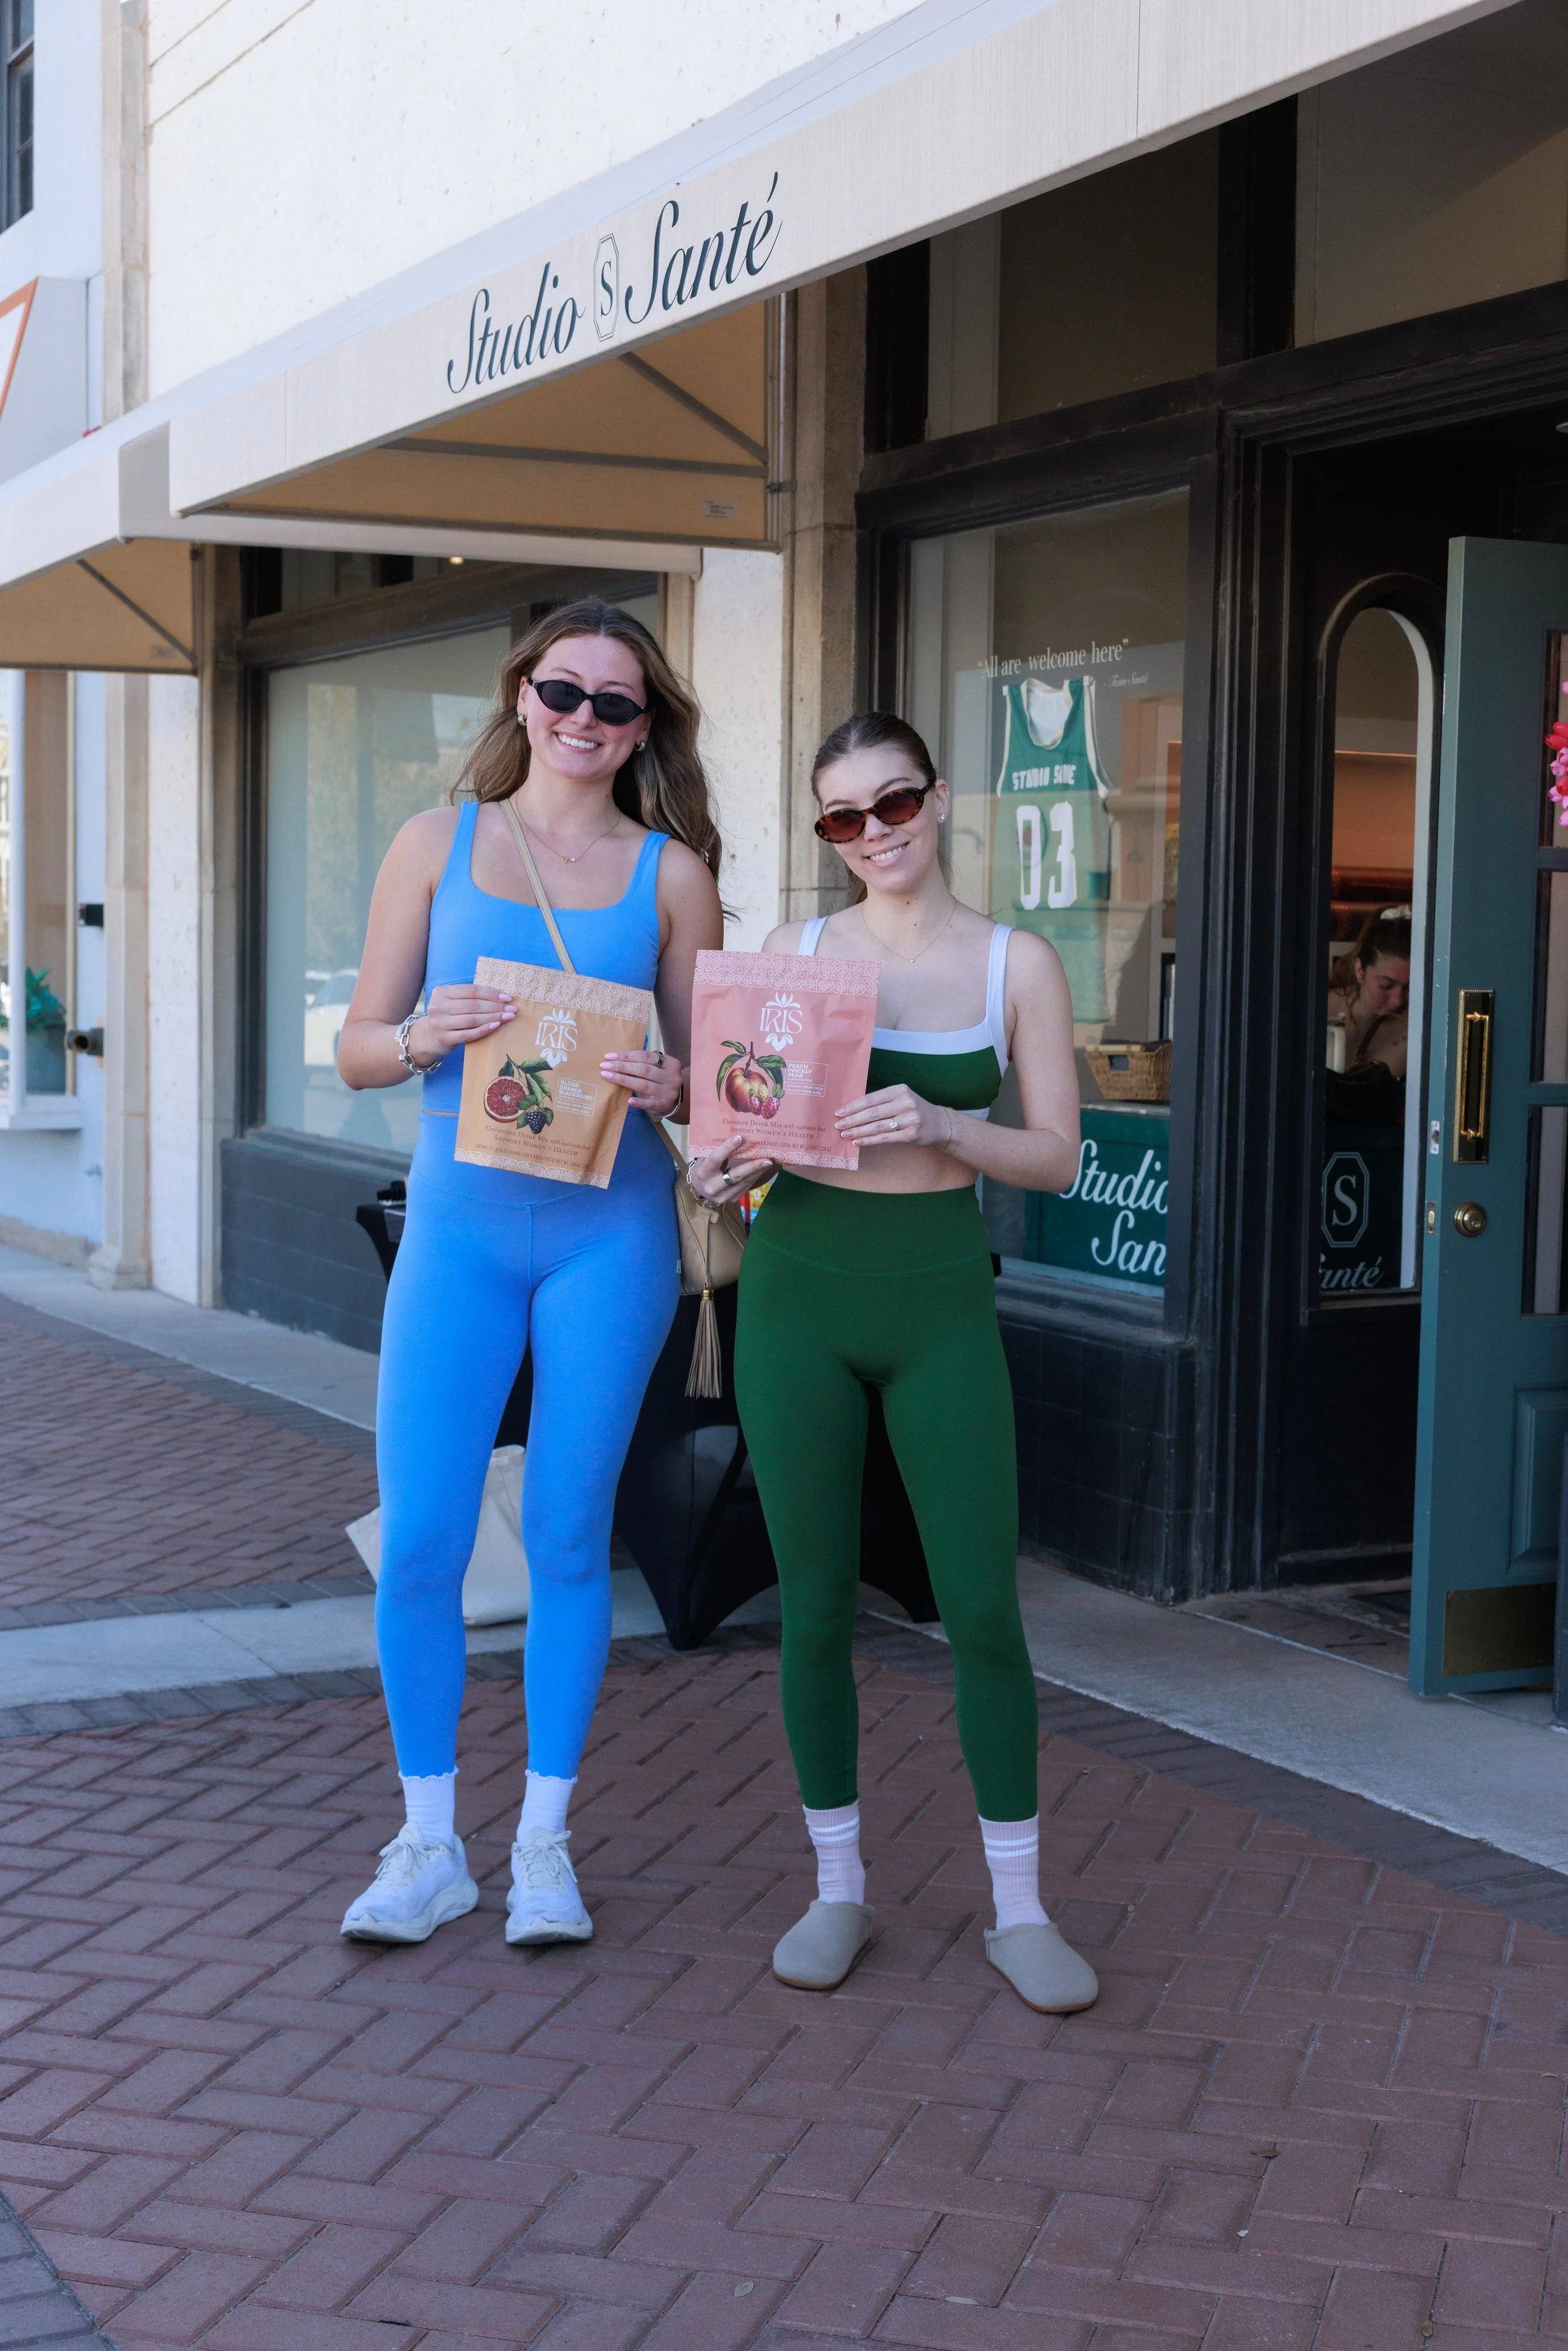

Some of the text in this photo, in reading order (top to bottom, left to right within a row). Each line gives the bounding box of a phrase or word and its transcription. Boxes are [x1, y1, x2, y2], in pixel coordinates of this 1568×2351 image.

[447, 171, 783, 393] Studio S Santé
[1001, 658, 1021, 676] are
[1029, 647, 1086, 671] welcome
[1012, 767, 1050, 791] STUDIO
[1016, 800, 1077, 910] 03
[759, 1008, 803, 1034] IRIS
[535, 1021, 578, 1051] IRIS
[558, 1090, 595, 1101] BLACKBERRY
[559, 1085, 583, 1093] ORANGE
[560, 1080, 580, 1088] BLOOD
[722, 1118, 748, 1127] Electrolyte
[756, 1128, 787, 1137] WOMEN'S
[485, 1125, 516, 1135] Electrolyte
[518, 1131, 536, 1140] Drink
[561, 1141, 581, 1149] nutrients
[494, 1134, 522, 1145] SUPPORT
[524, 1141, 551, 1151] WOMEN'S
[1332, 1175, 1358, 1226] S
